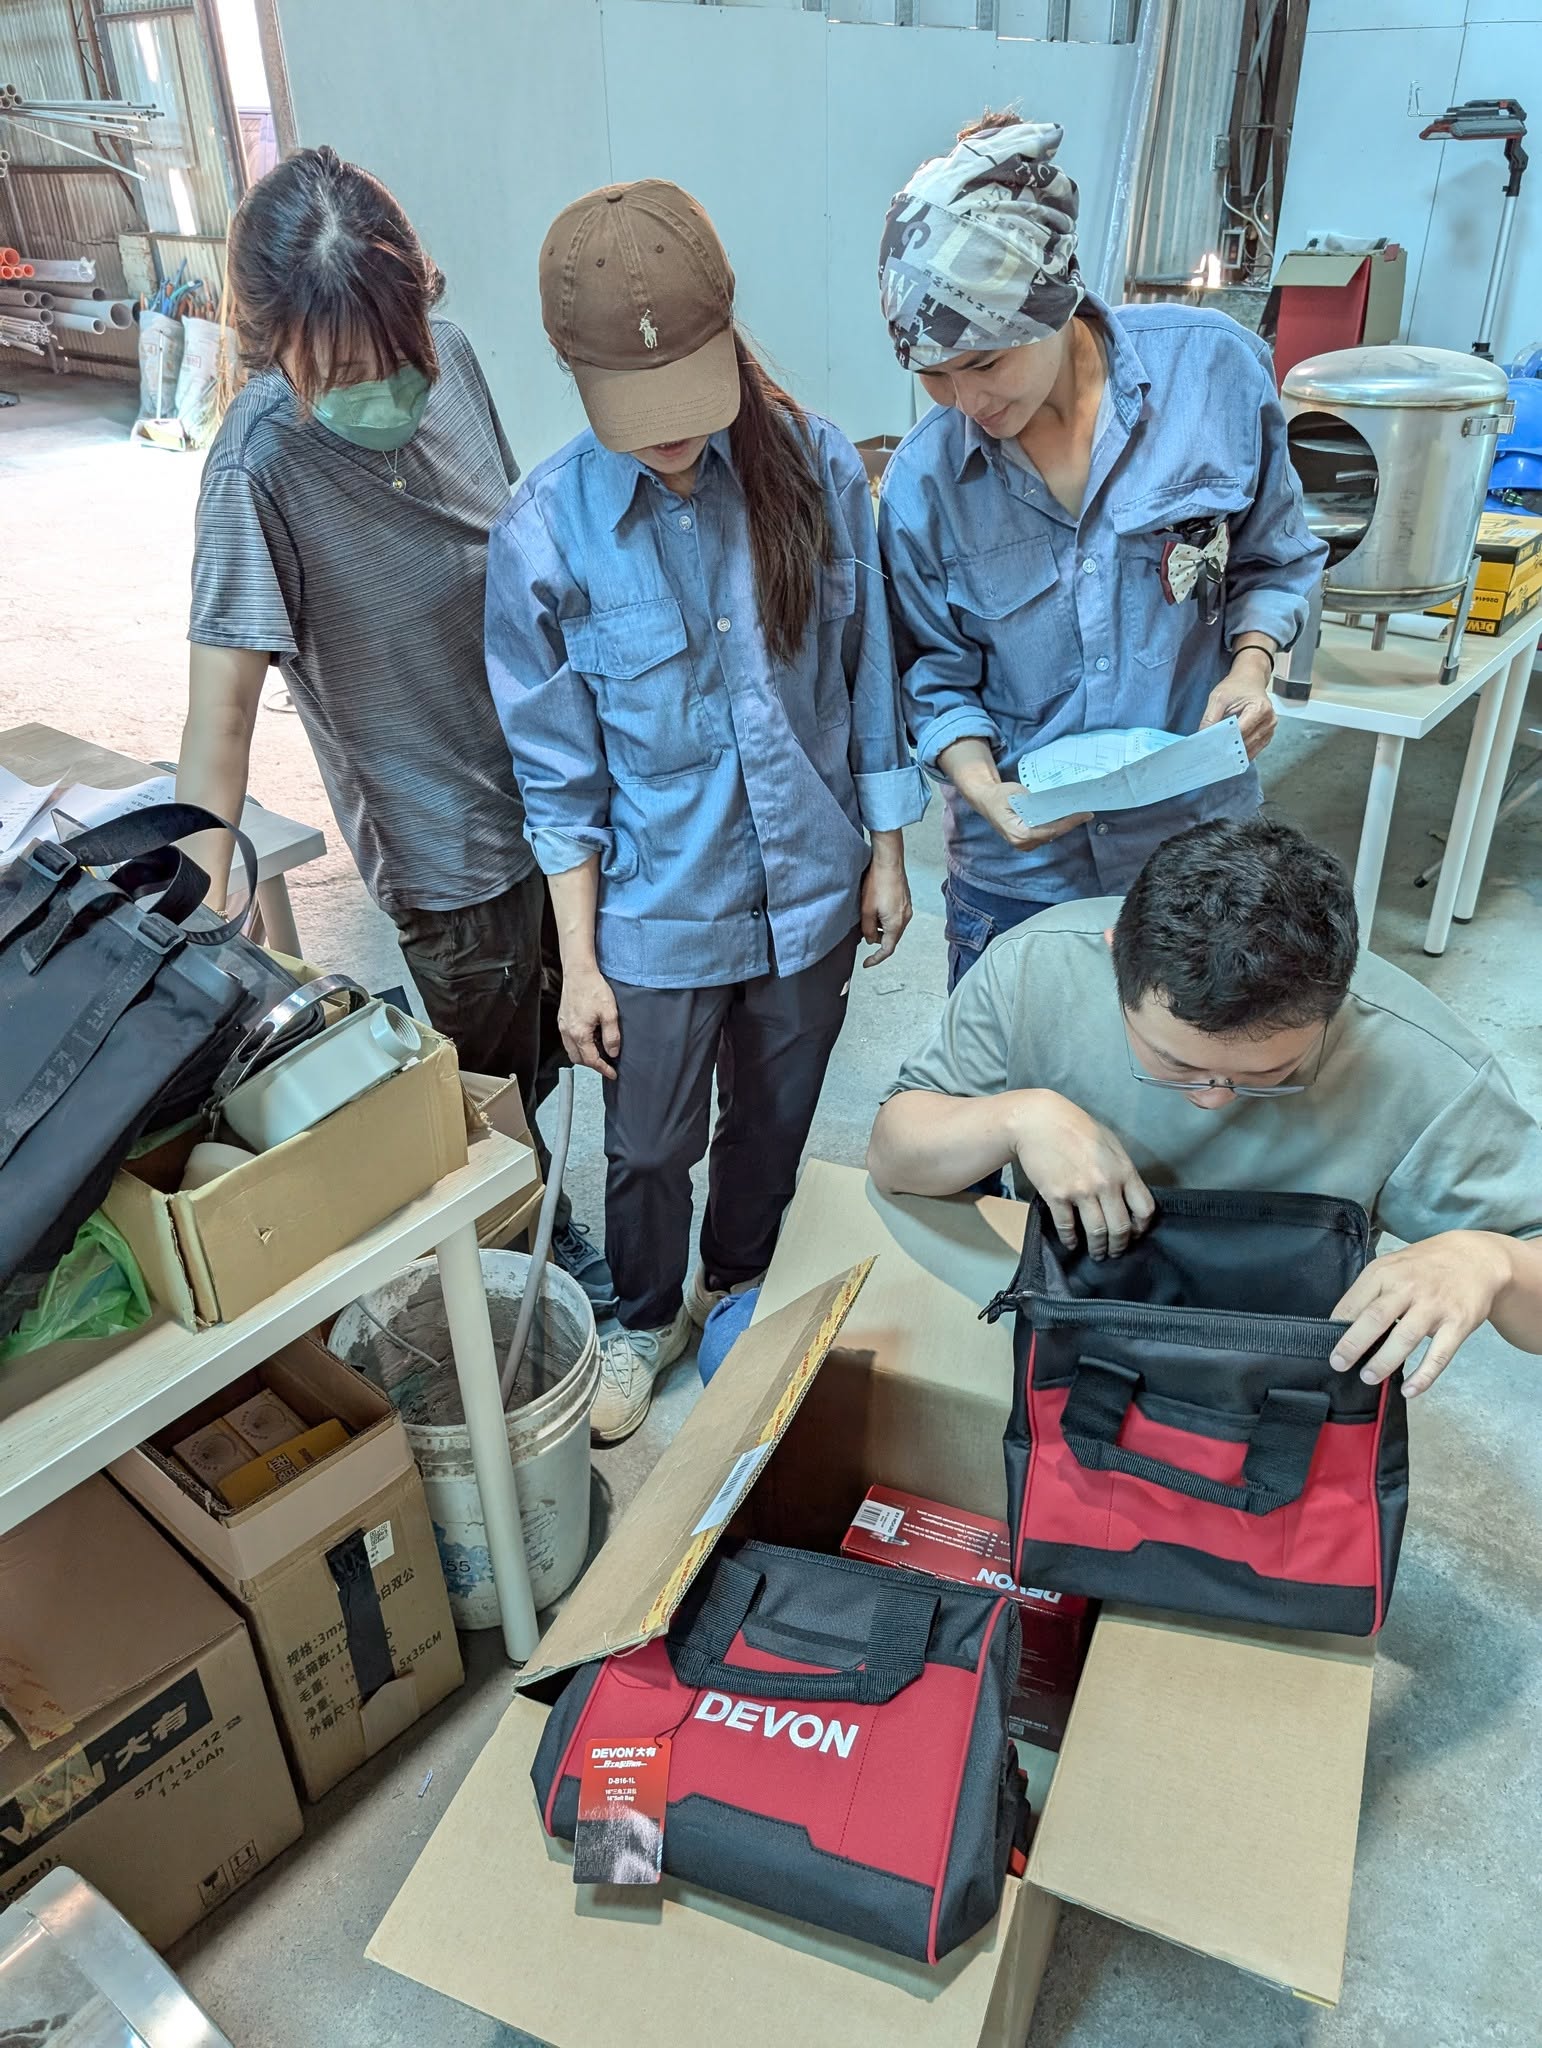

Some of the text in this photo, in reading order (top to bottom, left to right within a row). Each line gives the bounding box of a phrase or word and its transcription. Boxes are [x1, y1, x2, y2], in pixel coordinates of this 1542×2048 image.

[378, 1567, 416, 1601] 白双公
[115, 1701, 188, 1773] 大有
[694, 1691, 859, 1759] DEVON
[591, 1746, 657, 1759] DEVON 大有
